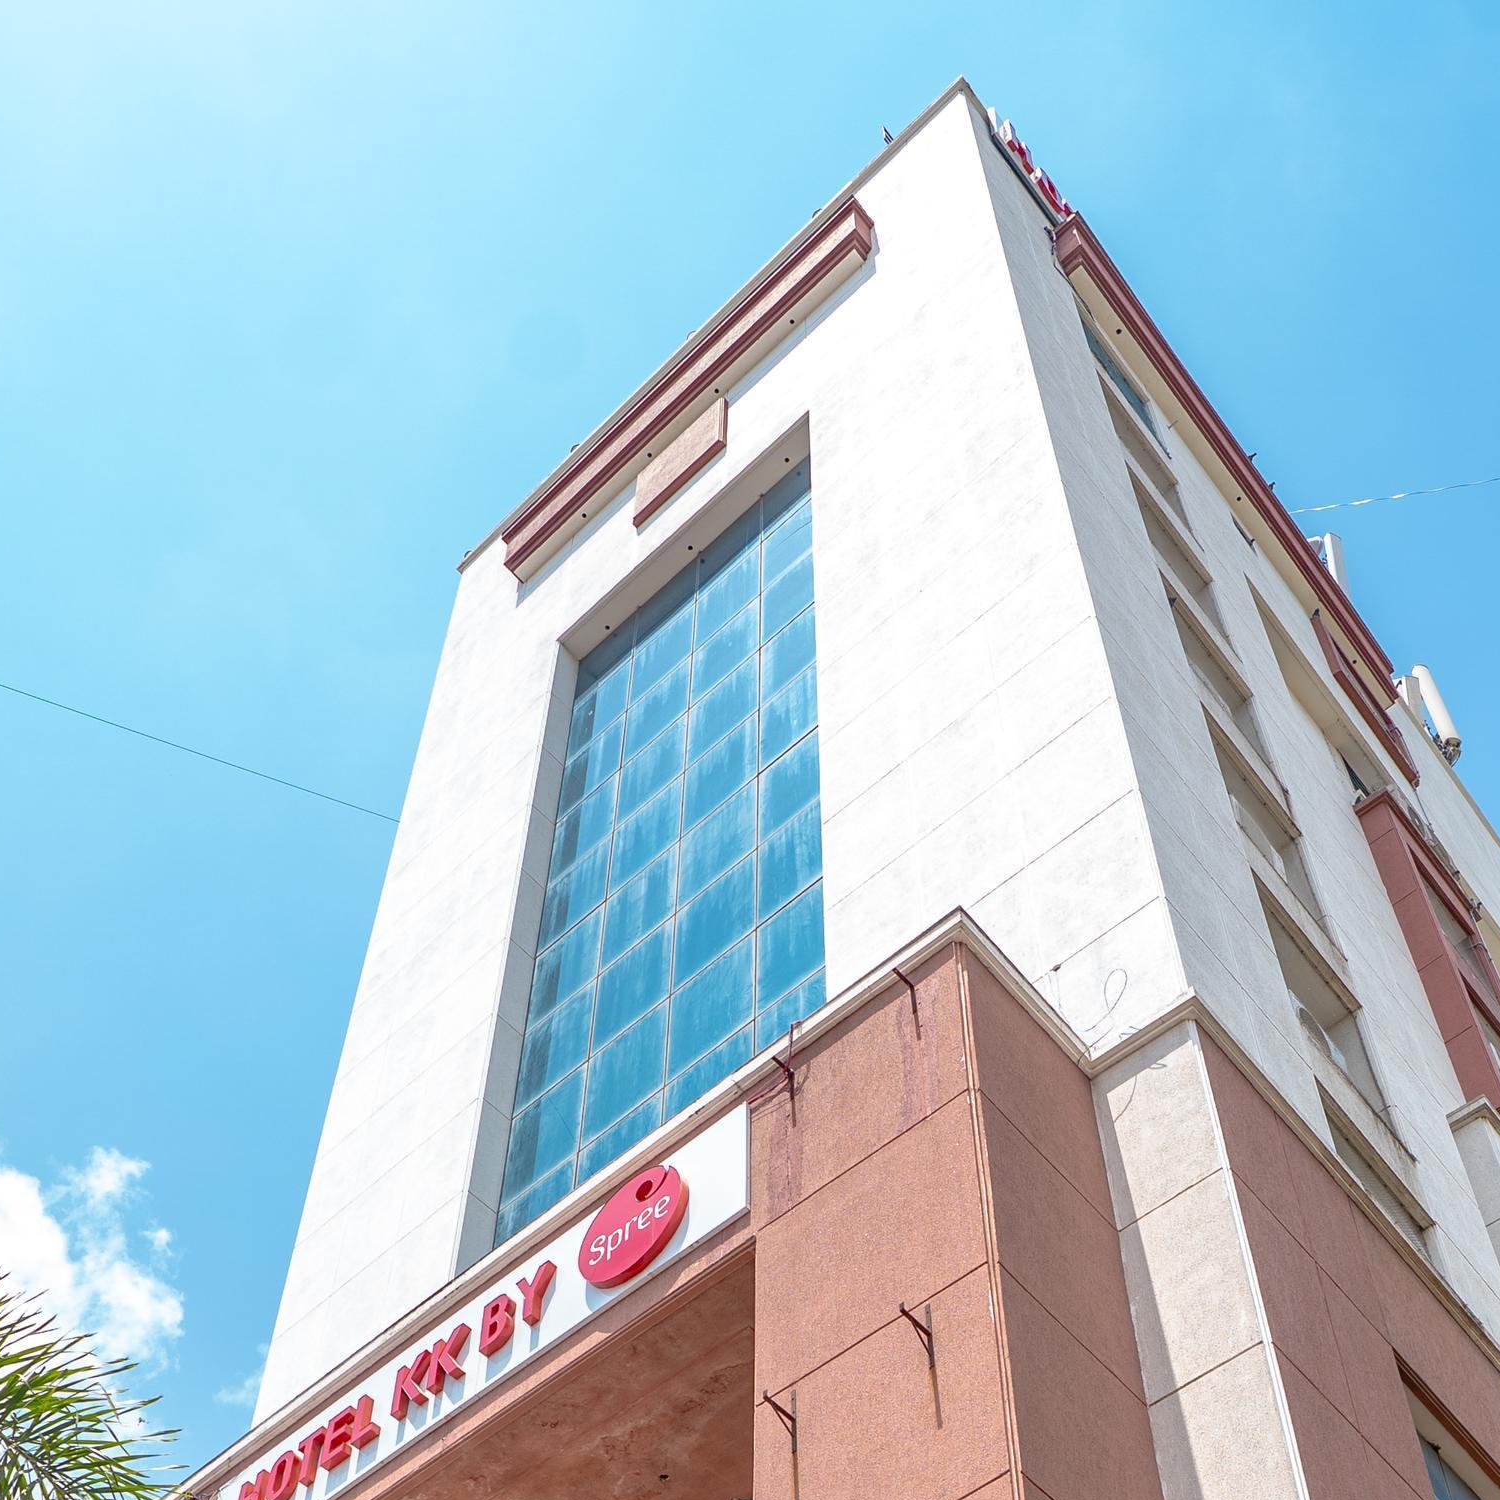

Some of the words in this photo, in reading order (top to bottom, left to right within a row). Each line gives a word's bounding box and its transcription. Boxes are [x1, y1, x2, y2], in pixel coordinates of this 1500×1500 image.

[390, 1322, 472, 1422] KK
[478, 1260, 558, 1358] BY
[588, 1195, 671, 1267] Spree
